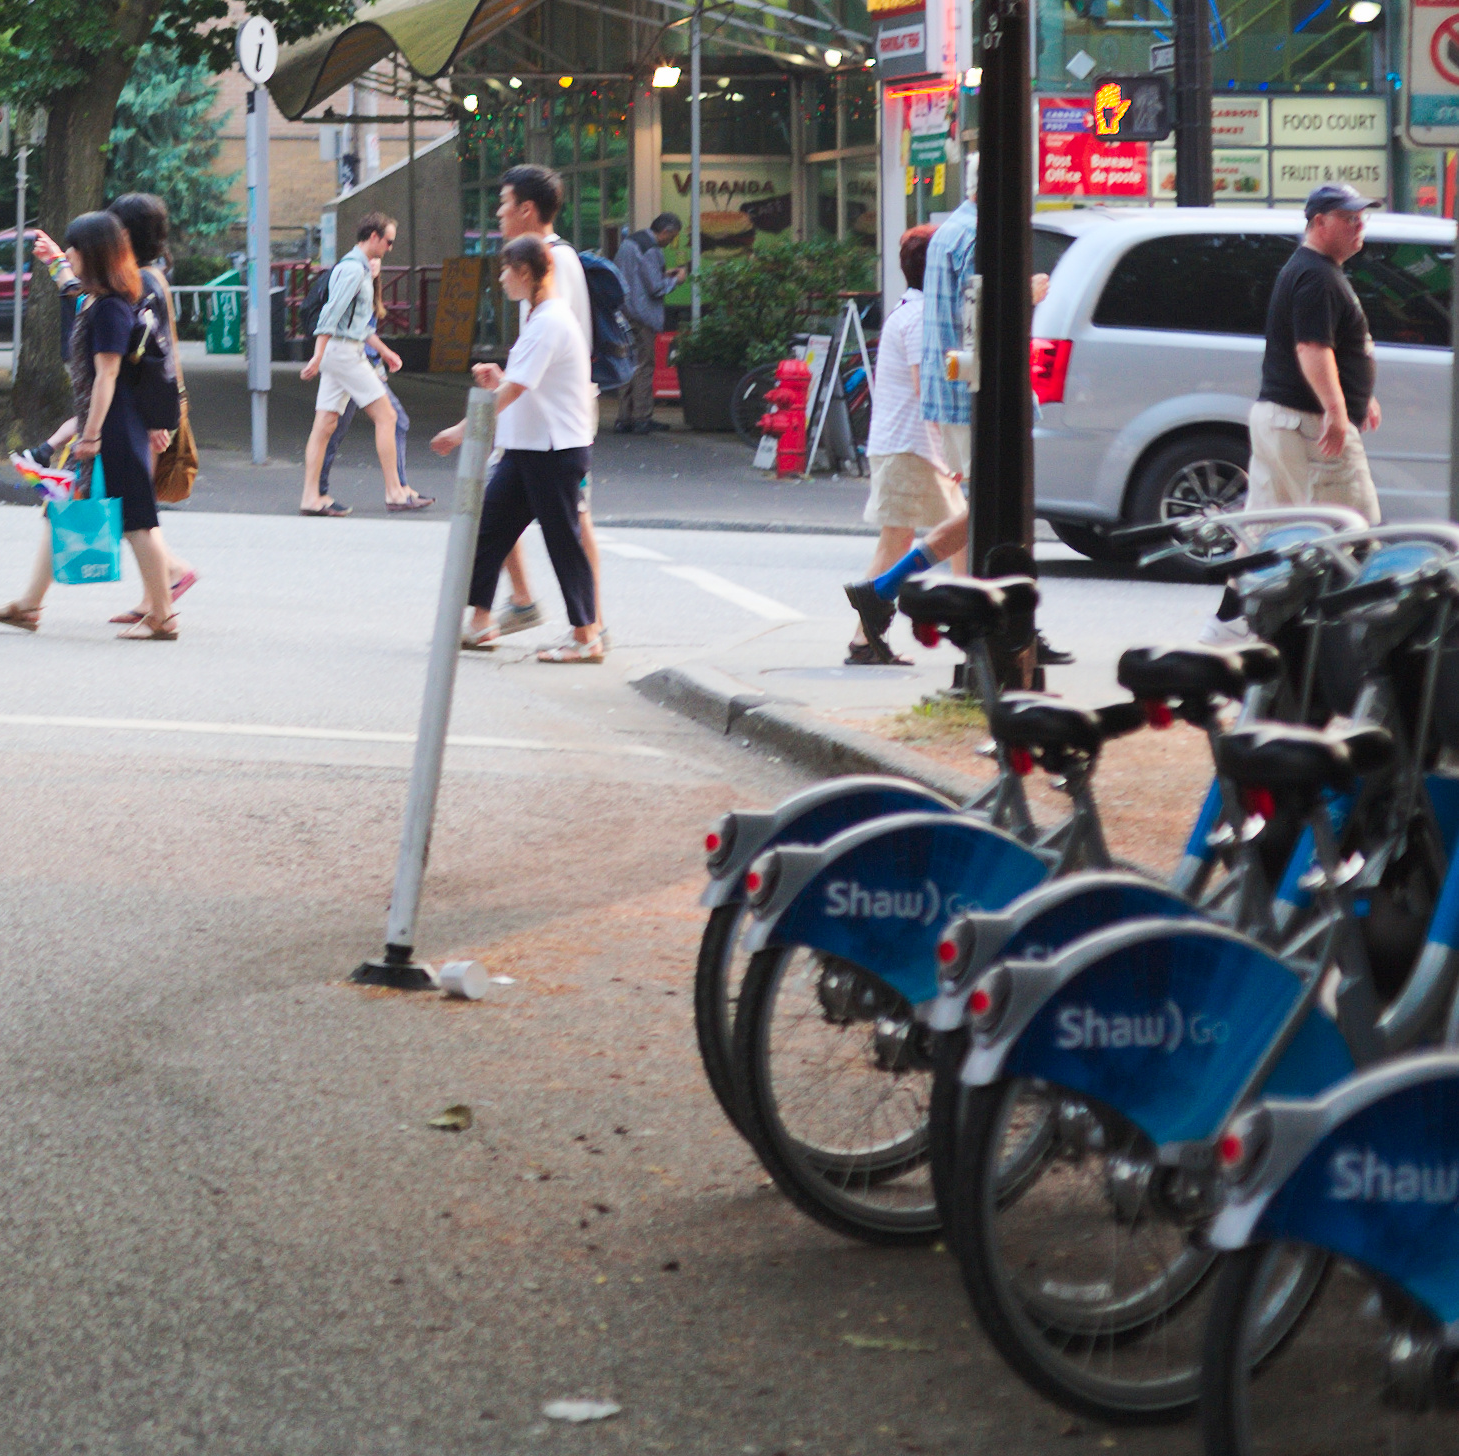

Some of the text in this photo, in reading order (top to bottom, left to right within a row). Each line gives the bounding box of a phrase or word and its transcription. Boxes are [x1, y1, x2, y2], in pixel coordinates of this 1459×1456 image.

[1211, 126, 1244, 135] ARKET
[1282, 113, 1377, 131] FOOD COURT
[1045, 153, 1133, 169] Post Bureau
[1045, 168, 1142, 187] Office de poste
[1281, 165, 1379, 182] FRUIT & MEATS
[673, 172, 774, 197] VRANDA
[1188, 1013, 1229, 1044] Go
